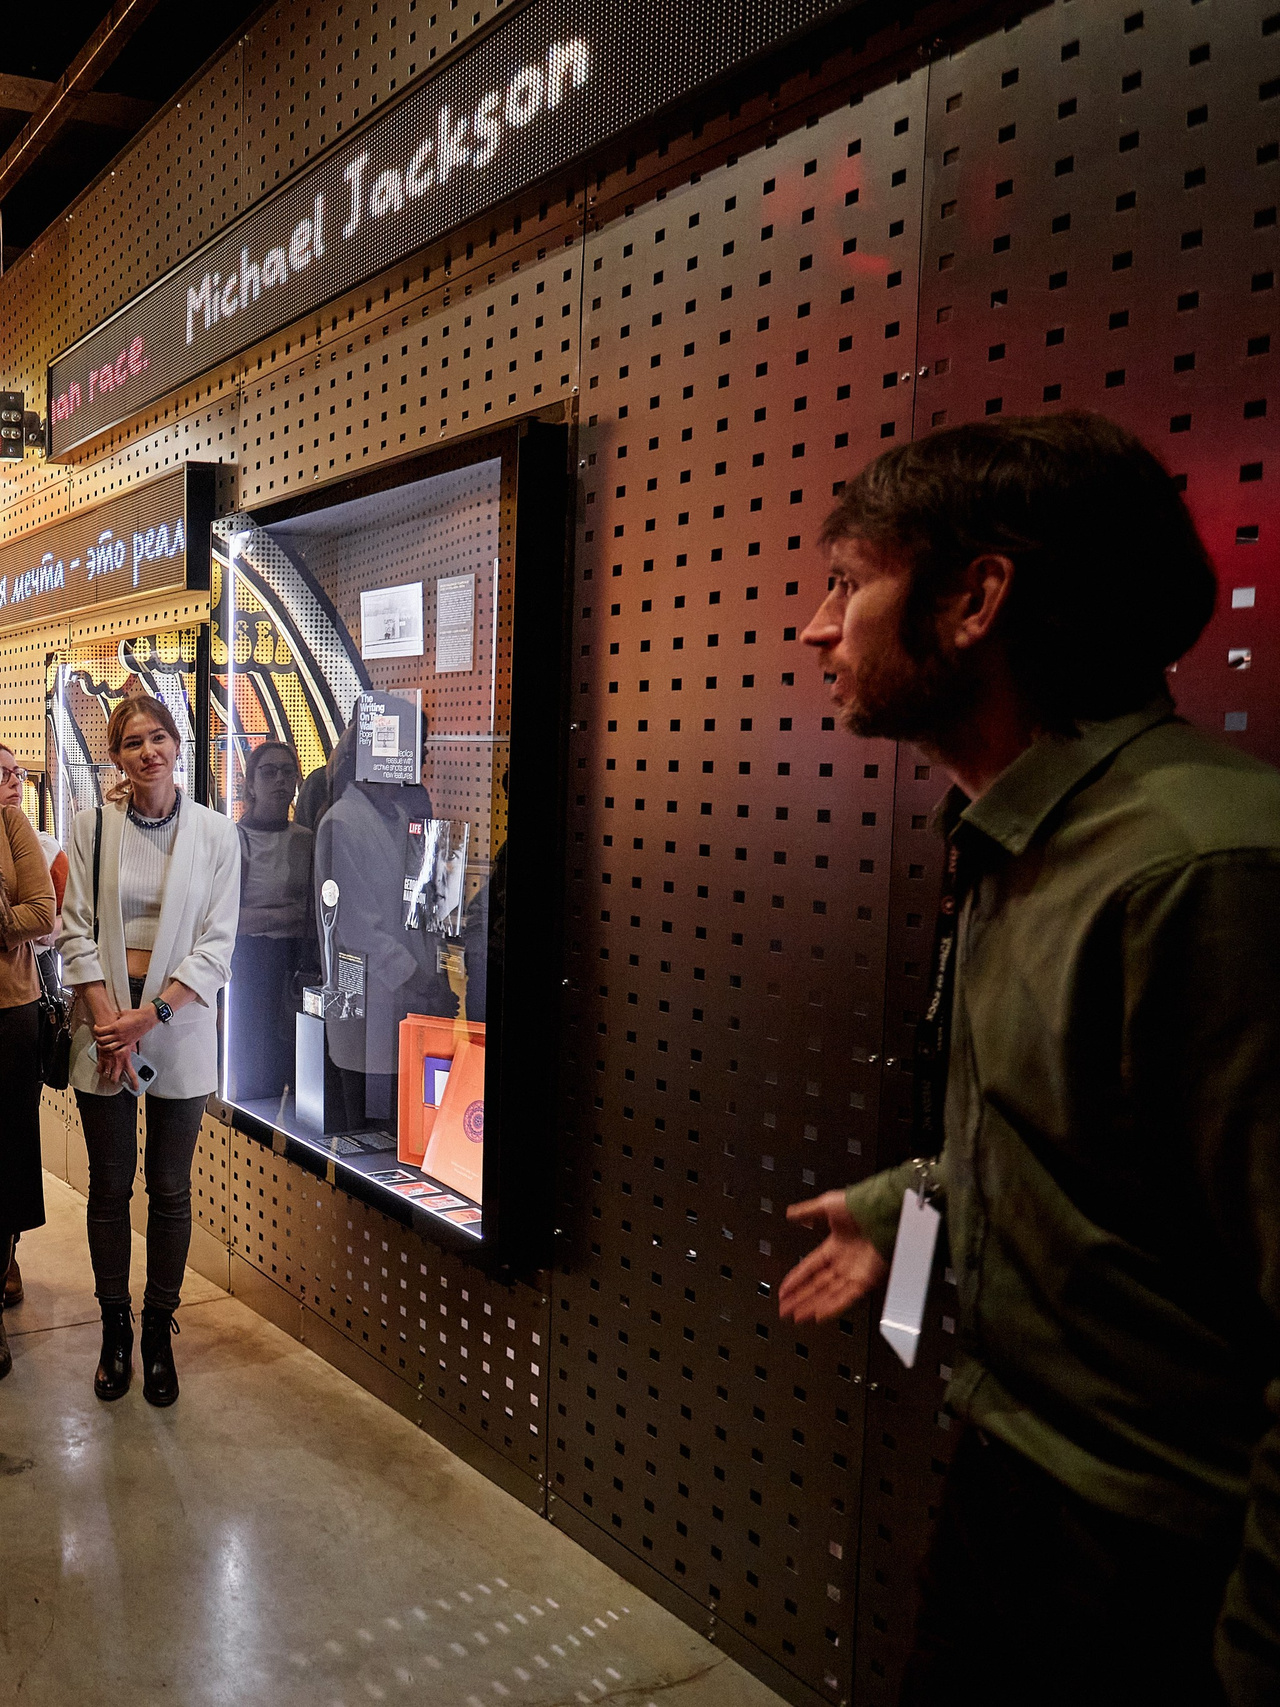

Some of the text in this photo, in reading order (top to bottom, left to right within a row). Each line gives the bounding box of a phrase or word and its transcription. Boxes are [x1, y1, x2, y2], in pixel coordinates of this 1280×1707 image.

[88, 335, 150, 404] race.
[186, 193, 326, 346] Michael
[341, 38, 590, 241] Jackson
[10, 551, 66, 603] мечта
[85, 529, 127, 580] это
[360, 694, 374, 703] The
[360, 702, 385, 714] Writing
[360, 712, 370, 721] On
[398, 749, 413, 758] eplica
[409, 823, 422, 834] LIFE
